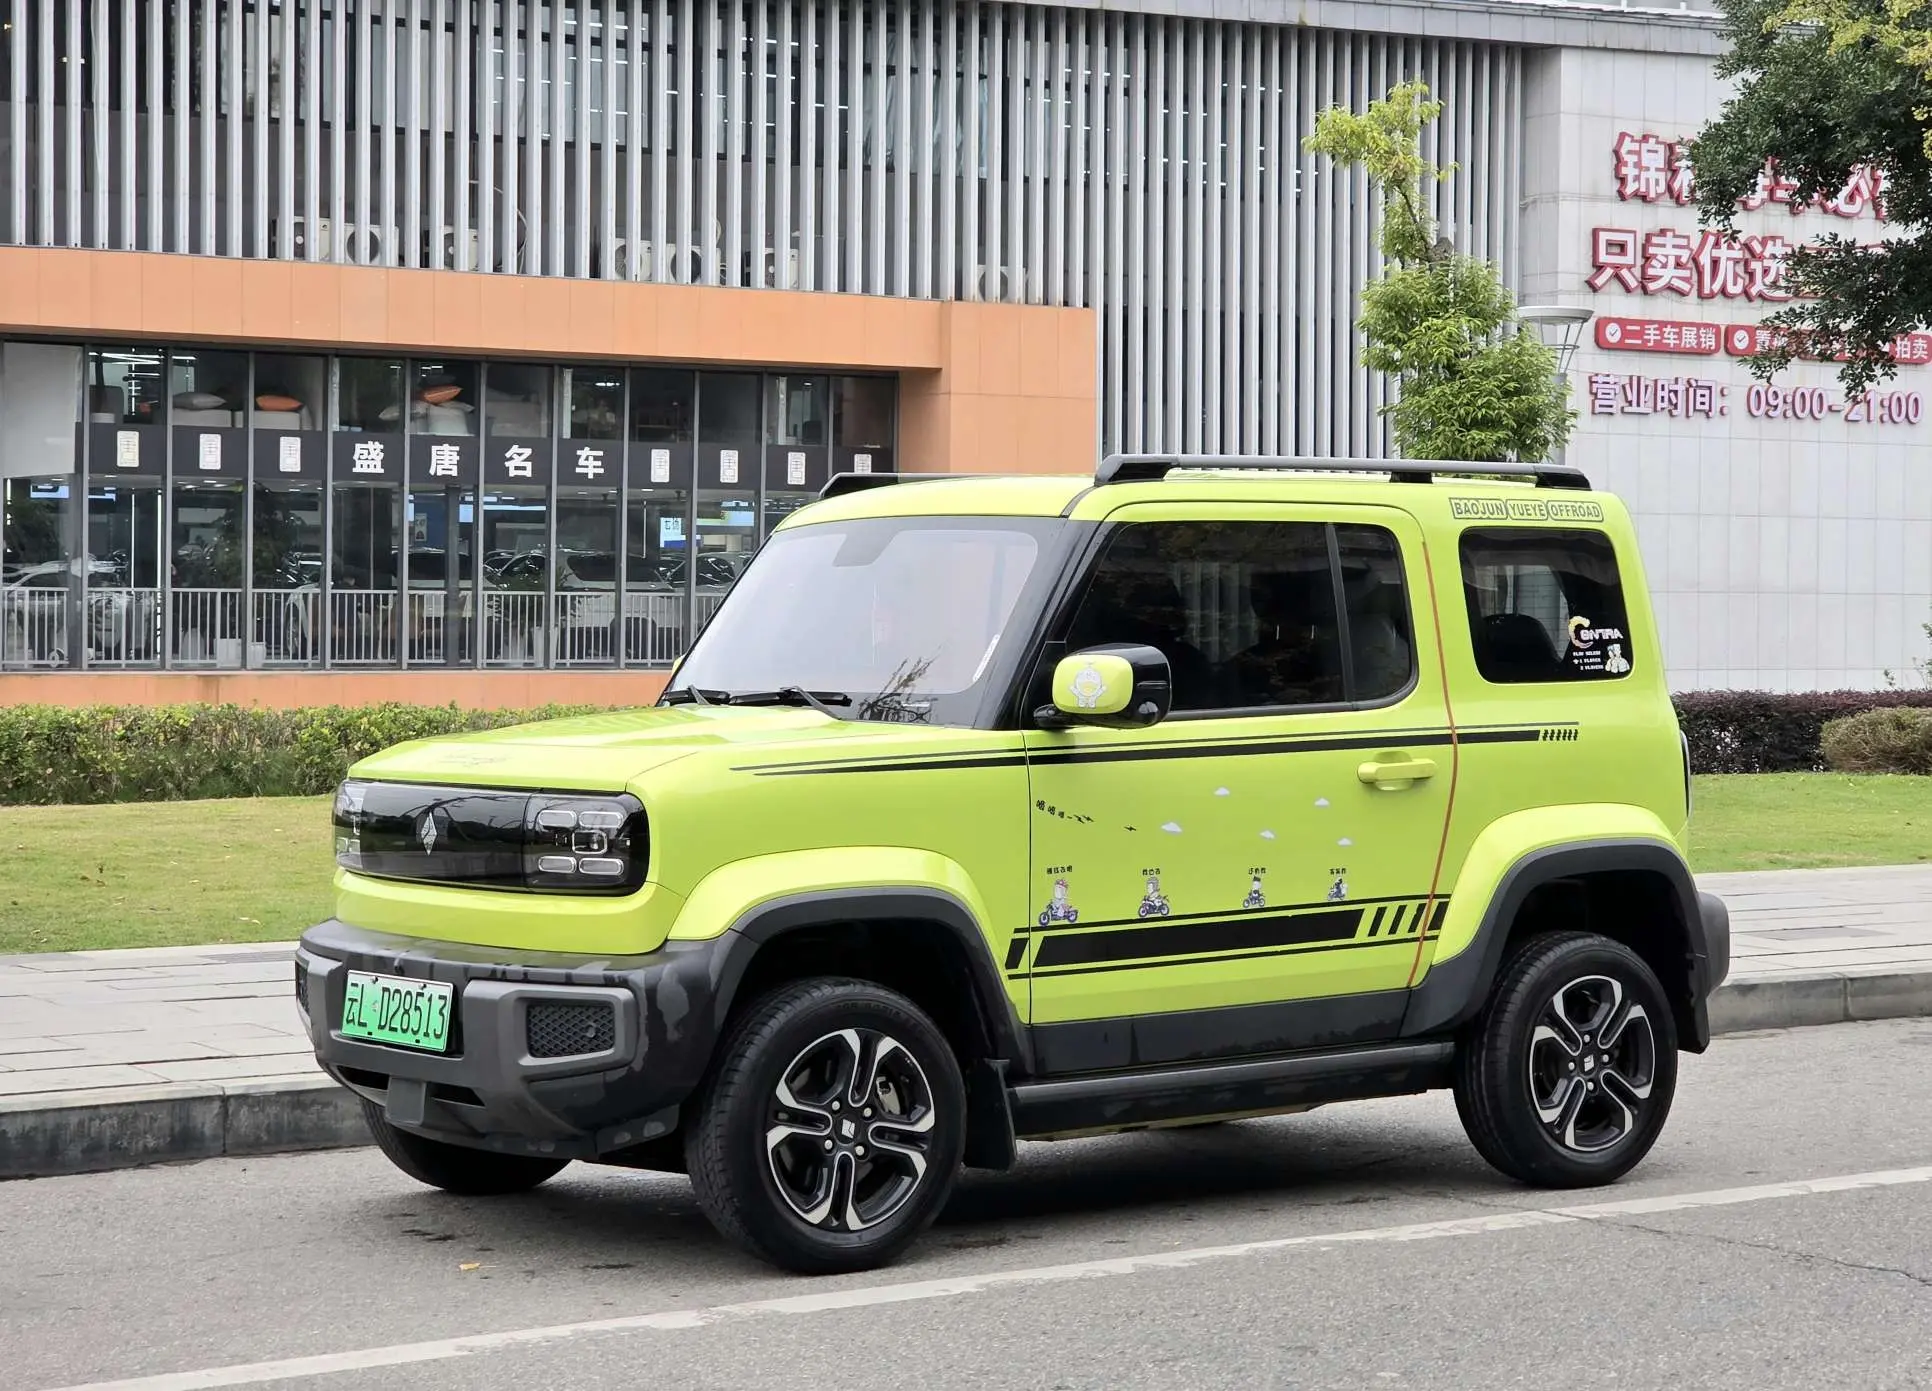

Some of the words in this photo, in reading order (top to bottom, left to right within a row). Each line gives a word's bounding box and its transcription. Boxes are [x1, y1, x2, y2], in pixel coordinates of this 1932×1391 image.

[1585, 226, 1893, 302] 只卖优选
[1624, 325, 1716, 351] 二手车展销
[352, 441, 605, 479] 盛唐名车
[1455, 502, 1505, 516] BAOJUN
[1509, 503, 1547, 517] YUEYE
[1550, 503, 1600, 518] OFFROAD
[377, 986, 448, 1040] D28513
